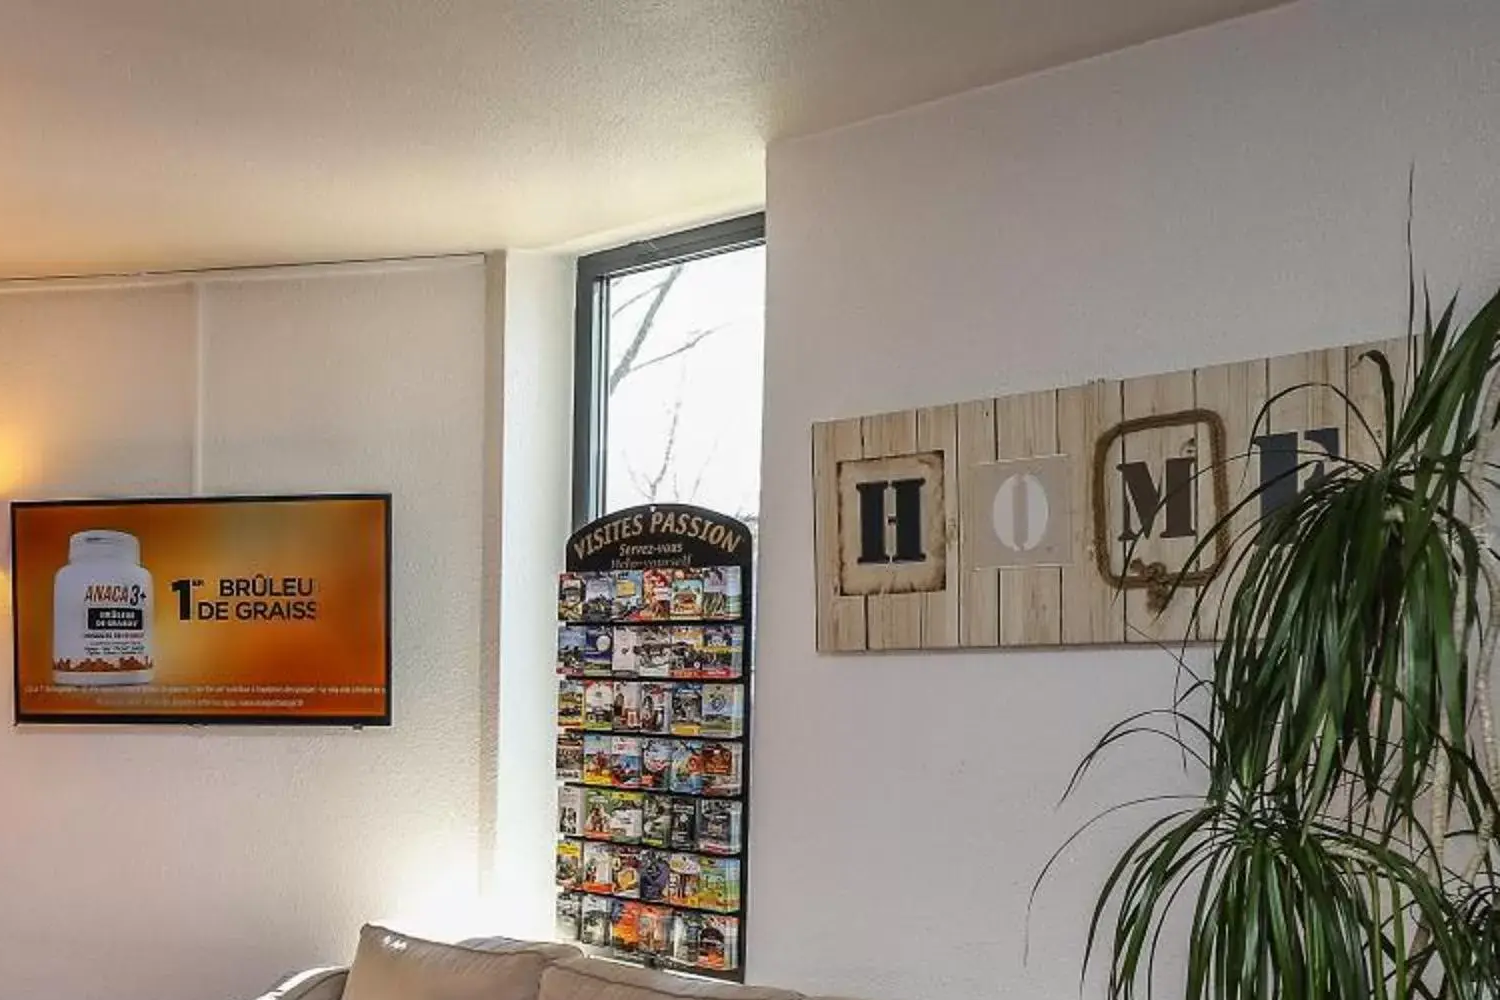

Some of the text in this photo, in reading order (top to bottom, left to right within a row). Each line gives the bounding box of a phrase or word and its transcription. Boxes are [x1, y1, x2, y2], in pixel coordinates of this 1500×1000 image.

[573, 511, 743, 560] VISITES PASSION
[198, 601, 228, 620] DE
